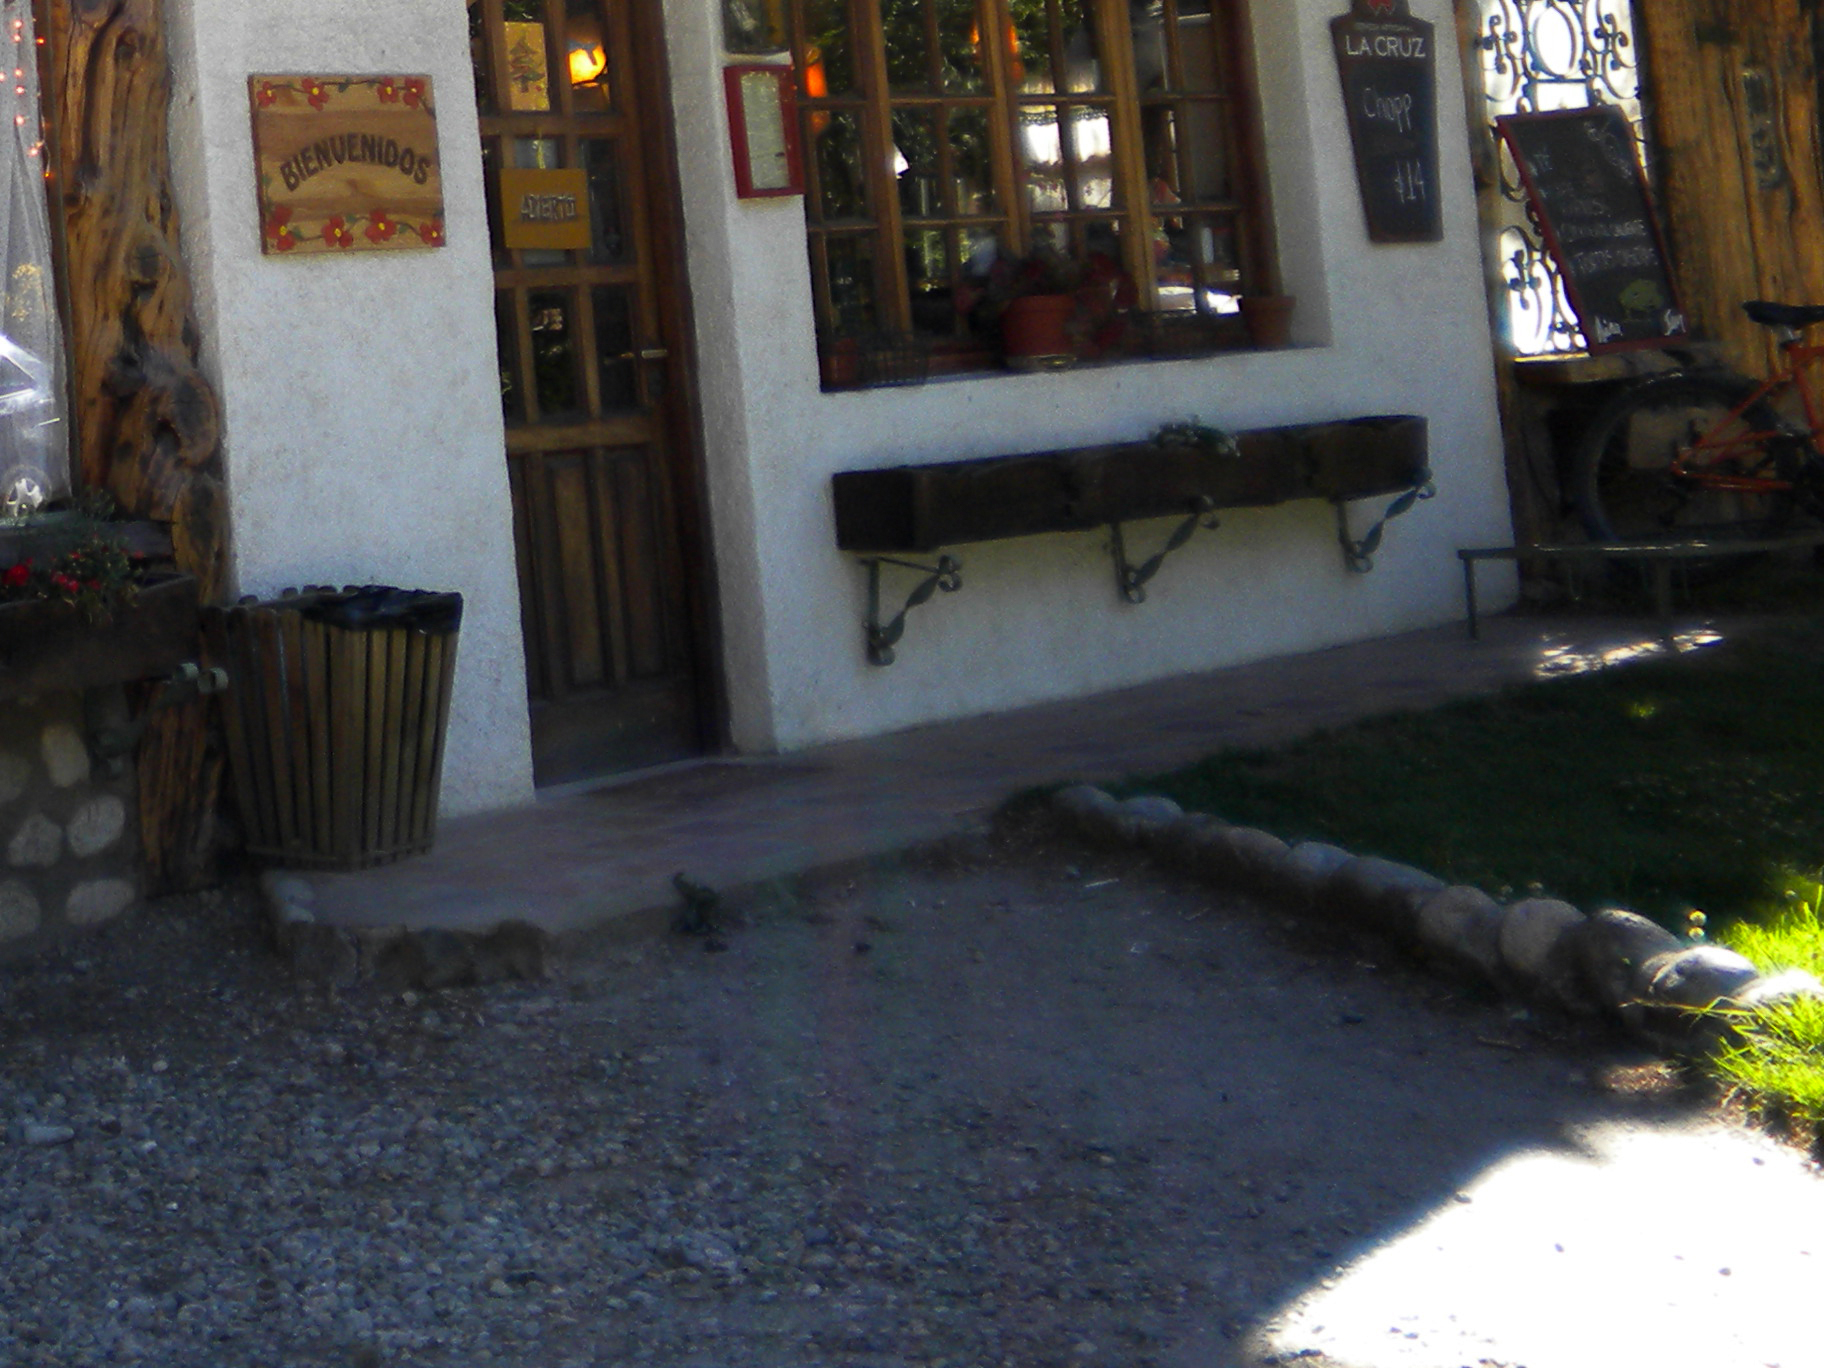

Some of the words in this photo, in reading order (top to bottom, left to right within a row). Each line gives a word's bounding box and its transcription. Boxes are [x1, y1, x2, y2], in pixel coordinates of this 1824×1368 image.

[1345, 35, 1373, 56] LA
[1375, 35, 1426, 58] CRUZ
[279, 132, 431, 192] BIENVENIDOS
